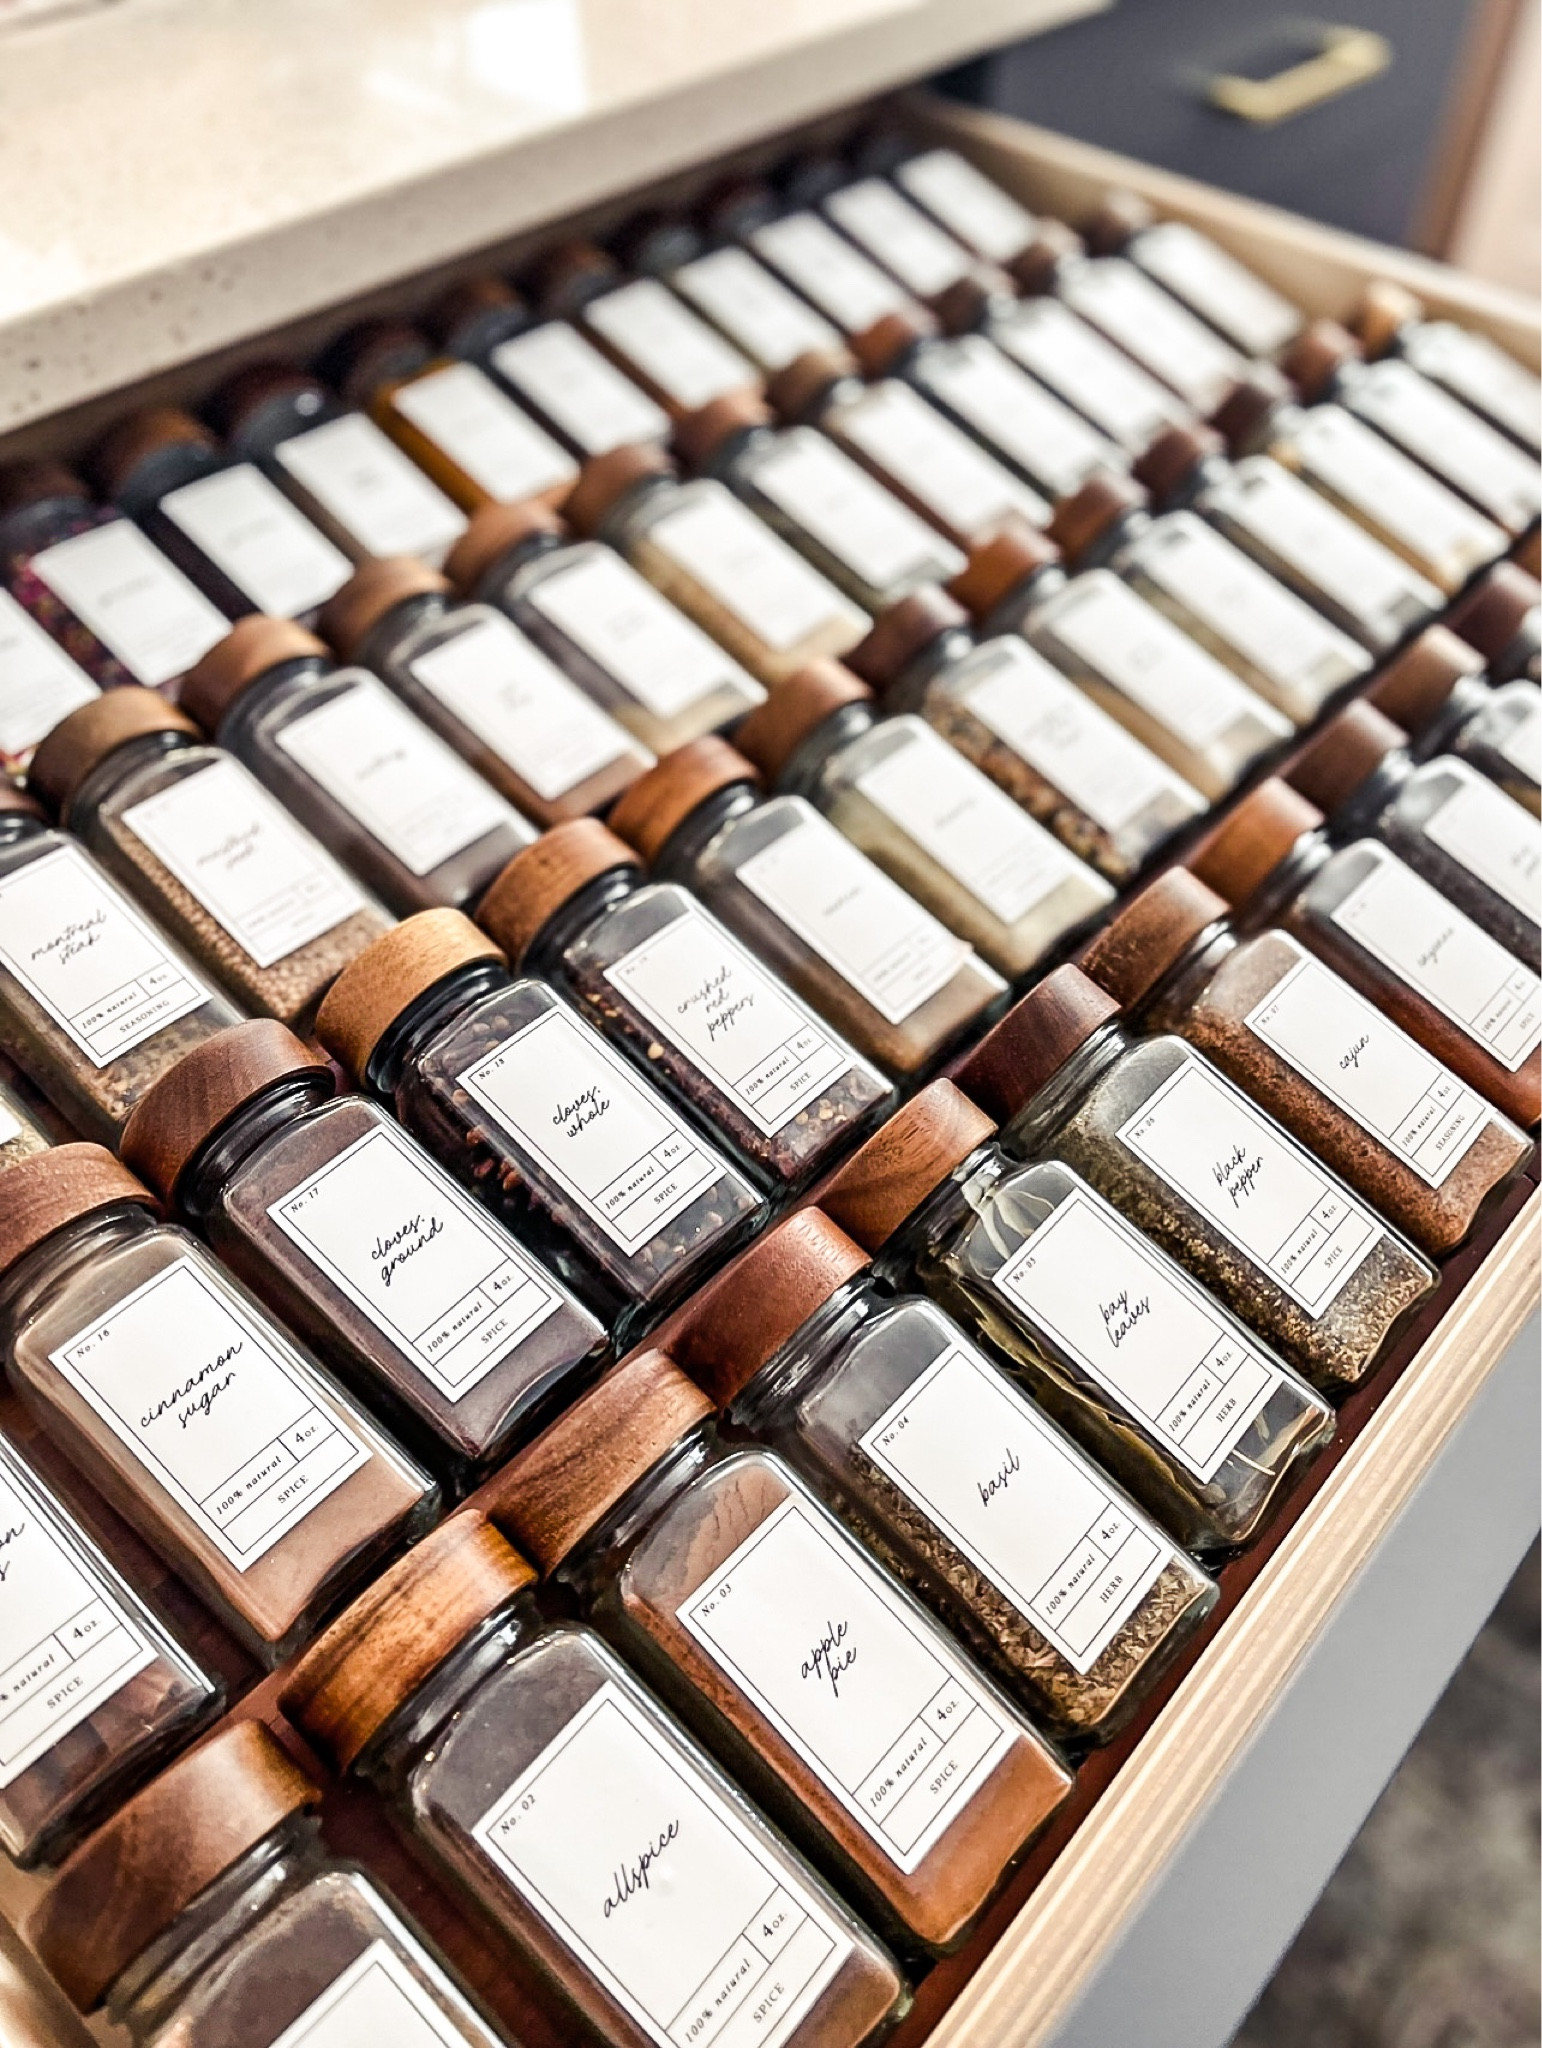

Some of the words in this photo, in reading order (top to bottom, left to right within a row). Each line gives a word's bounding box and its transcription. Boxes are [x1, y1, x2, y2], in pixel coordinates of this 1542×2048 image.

[678, 966, 731, 1014] crushed
[706, 988, 730, 1013] red
[120, 1000, 170, 1032] SEASONING
[707, 994, 754, 1042] peppers
[1340, 1034, 1370, 1069] cajun
[479, 1068, 494, 1080] No.
[790, 1072, 812, 1091] SPICE
[566, 1100, 610, 1138] whole
[1402, 1128, 1418, 1147] 100%
[1436, 1114, 1466, 1150] SEASONING
[1212, 1144, 1246, 1186] black
[1228, 1157, 1263, 1208] pepper
[292, 1200, 307, 1213] No.
[308, 1188, 320, 1199] 17
[605, 1190, 626, 1210] 100%
[628, 1166, 654, 1191] natural
[654, 1184, 678, 1204] SPICE
[382, 1217, 444, 1286] ground
[1280, 1253, 1297, 1274] 100%
[1298, 1228, 1318, 1254] natural
[1324, 1246, 1342, 1268] SPICE
[1012, 1268, 1028, 1283] No.
[426, 1332, 450, 1352] 100%
[452, 1301, 483, 1330] natural
[1100, 1291, 1128, 1324] bay
[1106, 1296, 1150, 1348] leaves
[480, 1318, 508, 1344] SPICE
[78, 1343, 96, 1358] No.
[141, 1342, 242, 1427] cinnamon
[178, 1372, 236, 1428] sugar
[1168, 1409, 1187, 1432] 100%
[1187, 1379, 1212, 1410] natural
[1216, 1398, 1237, 1424] HERB
[882, 1431, 899, 1446] No.
[898, 1416, 910, 1430] 04
[216, 1490, 244, 1514] 100%
[246, 1456, 282, 1489] natural
[277, 1474, 309, 1504] SPICE
[978, 1448, 1019, 1507] basil
[702, 1600, 720, 1617] No.
[720, 1583, 732, 1598] 03
[1045, 1589, 1067, 1615] 100%
[1069, 1554, 1096, 1588] natural
[1100, 1576, 1124, 1604] HERB
[802, 1621, 847, 1679] apple
[13, 1654, 55, 1692] natural
[830, 1648, 856, 1698] pie
[46, 1676, 84, 1709] SPICE
[870, 1779, 893, 1808] 100%
[896, 1738, 928, 1777] natural
[930, 1760, 958, 1794] SPICE
[500, 1815, 521, 1834] No.
[522, 1794, 536, 1811] 02
[604, 1820, 679, 1918] allspice
[685, 2009, 712, 2043] 100%
[716, 1958, 751, 2007] natural
[754, 1983, 784, 2024] SPICE
